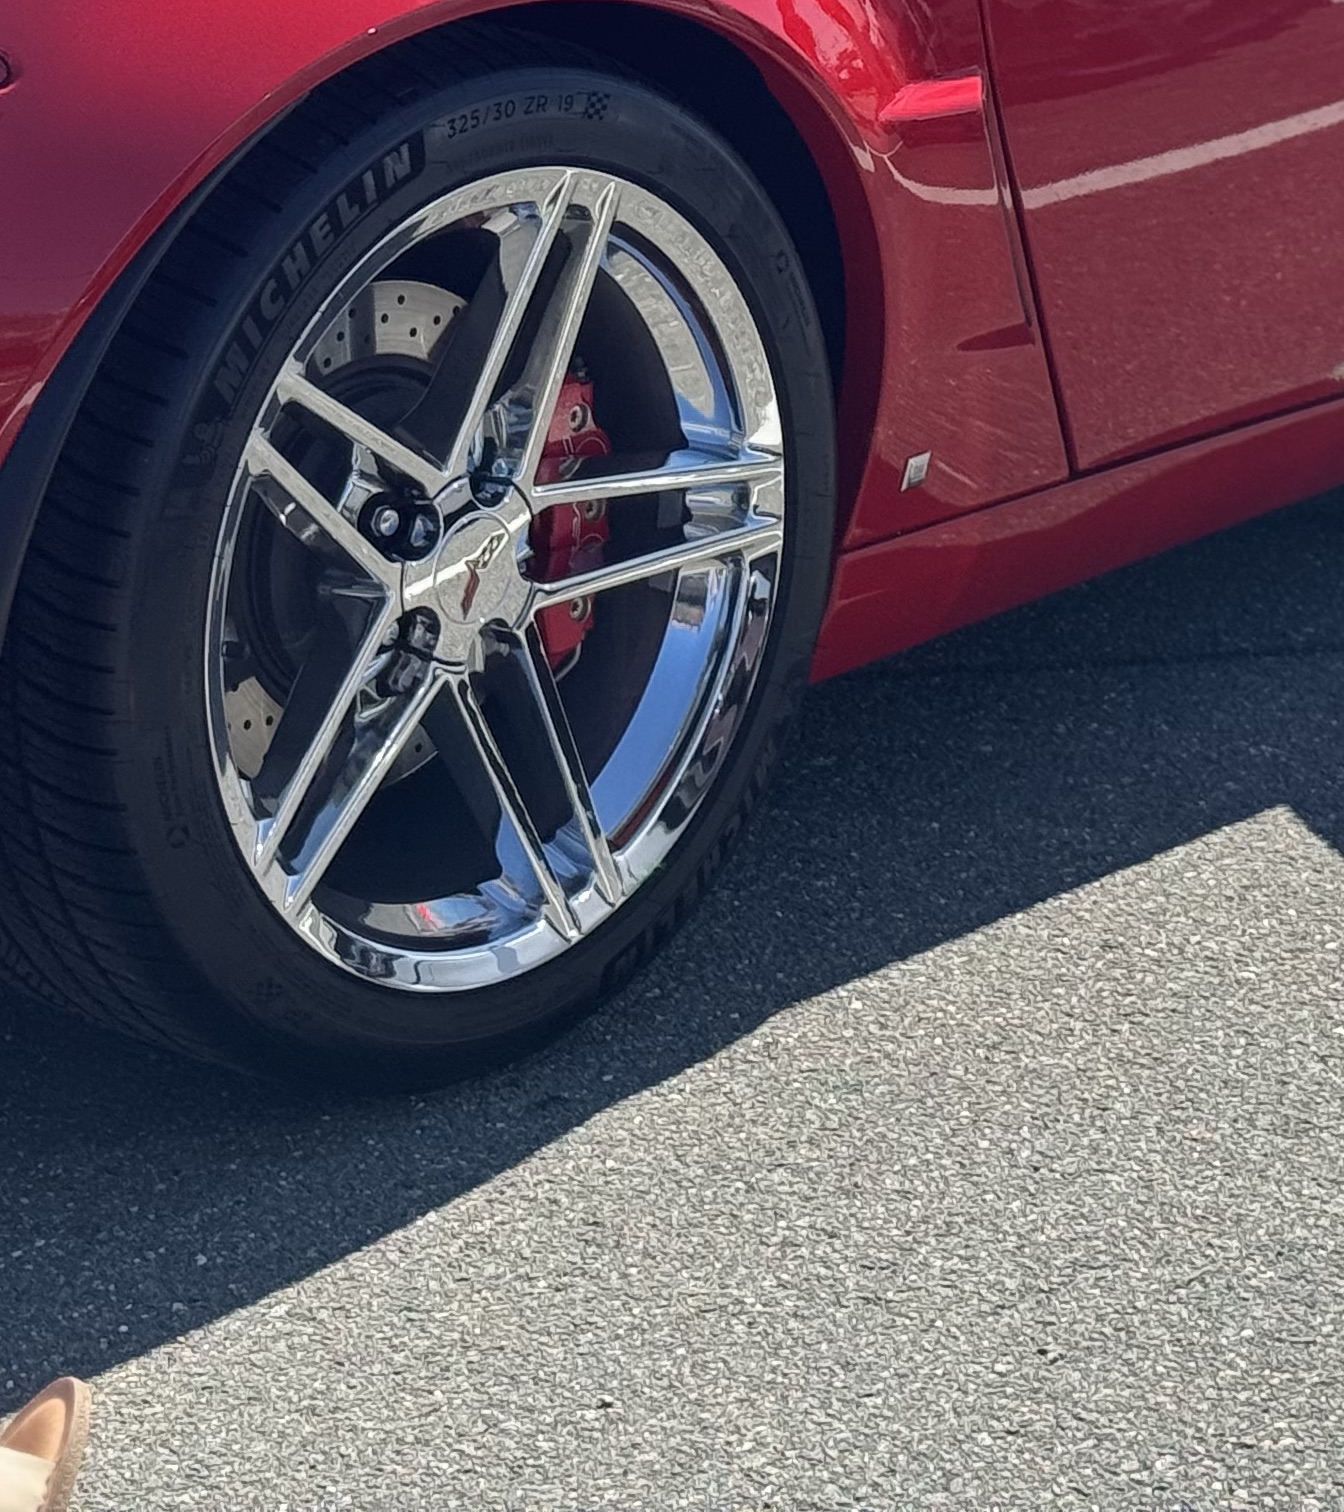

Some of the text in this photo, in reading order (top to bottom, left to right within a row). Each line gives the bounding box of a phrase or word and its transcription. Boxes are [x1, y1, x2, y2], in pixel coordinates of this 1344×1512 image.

[446, 94, 575, 140] 325/30 ZR 19
[213, 141, 413, 405] MICHELIN
